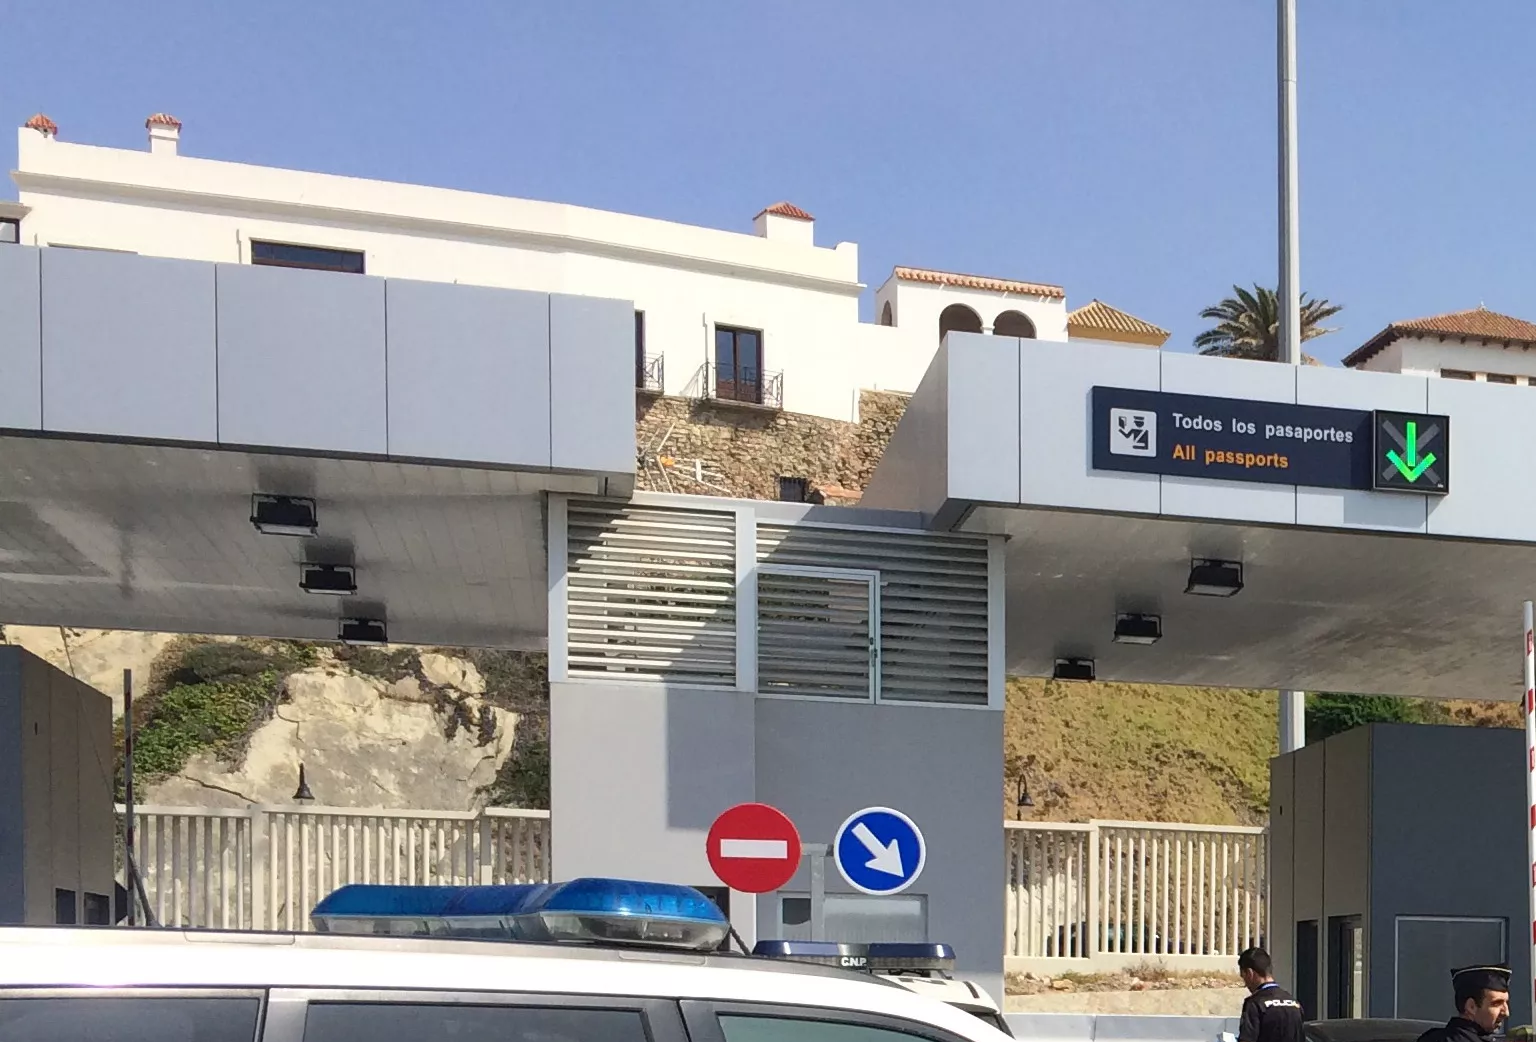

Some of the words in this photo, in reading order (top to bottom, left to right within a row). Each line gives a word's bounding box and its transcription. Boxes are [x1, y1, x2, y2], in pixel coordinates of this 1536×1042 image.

[1172, 413, 1223, 432] Todos
[1232, 418, 1257, 435] los
[1265, 423, 1354, 444] pasaportes
[1172, 444, 1196, 460] All
[1205, 446, 1289, 469] passports
